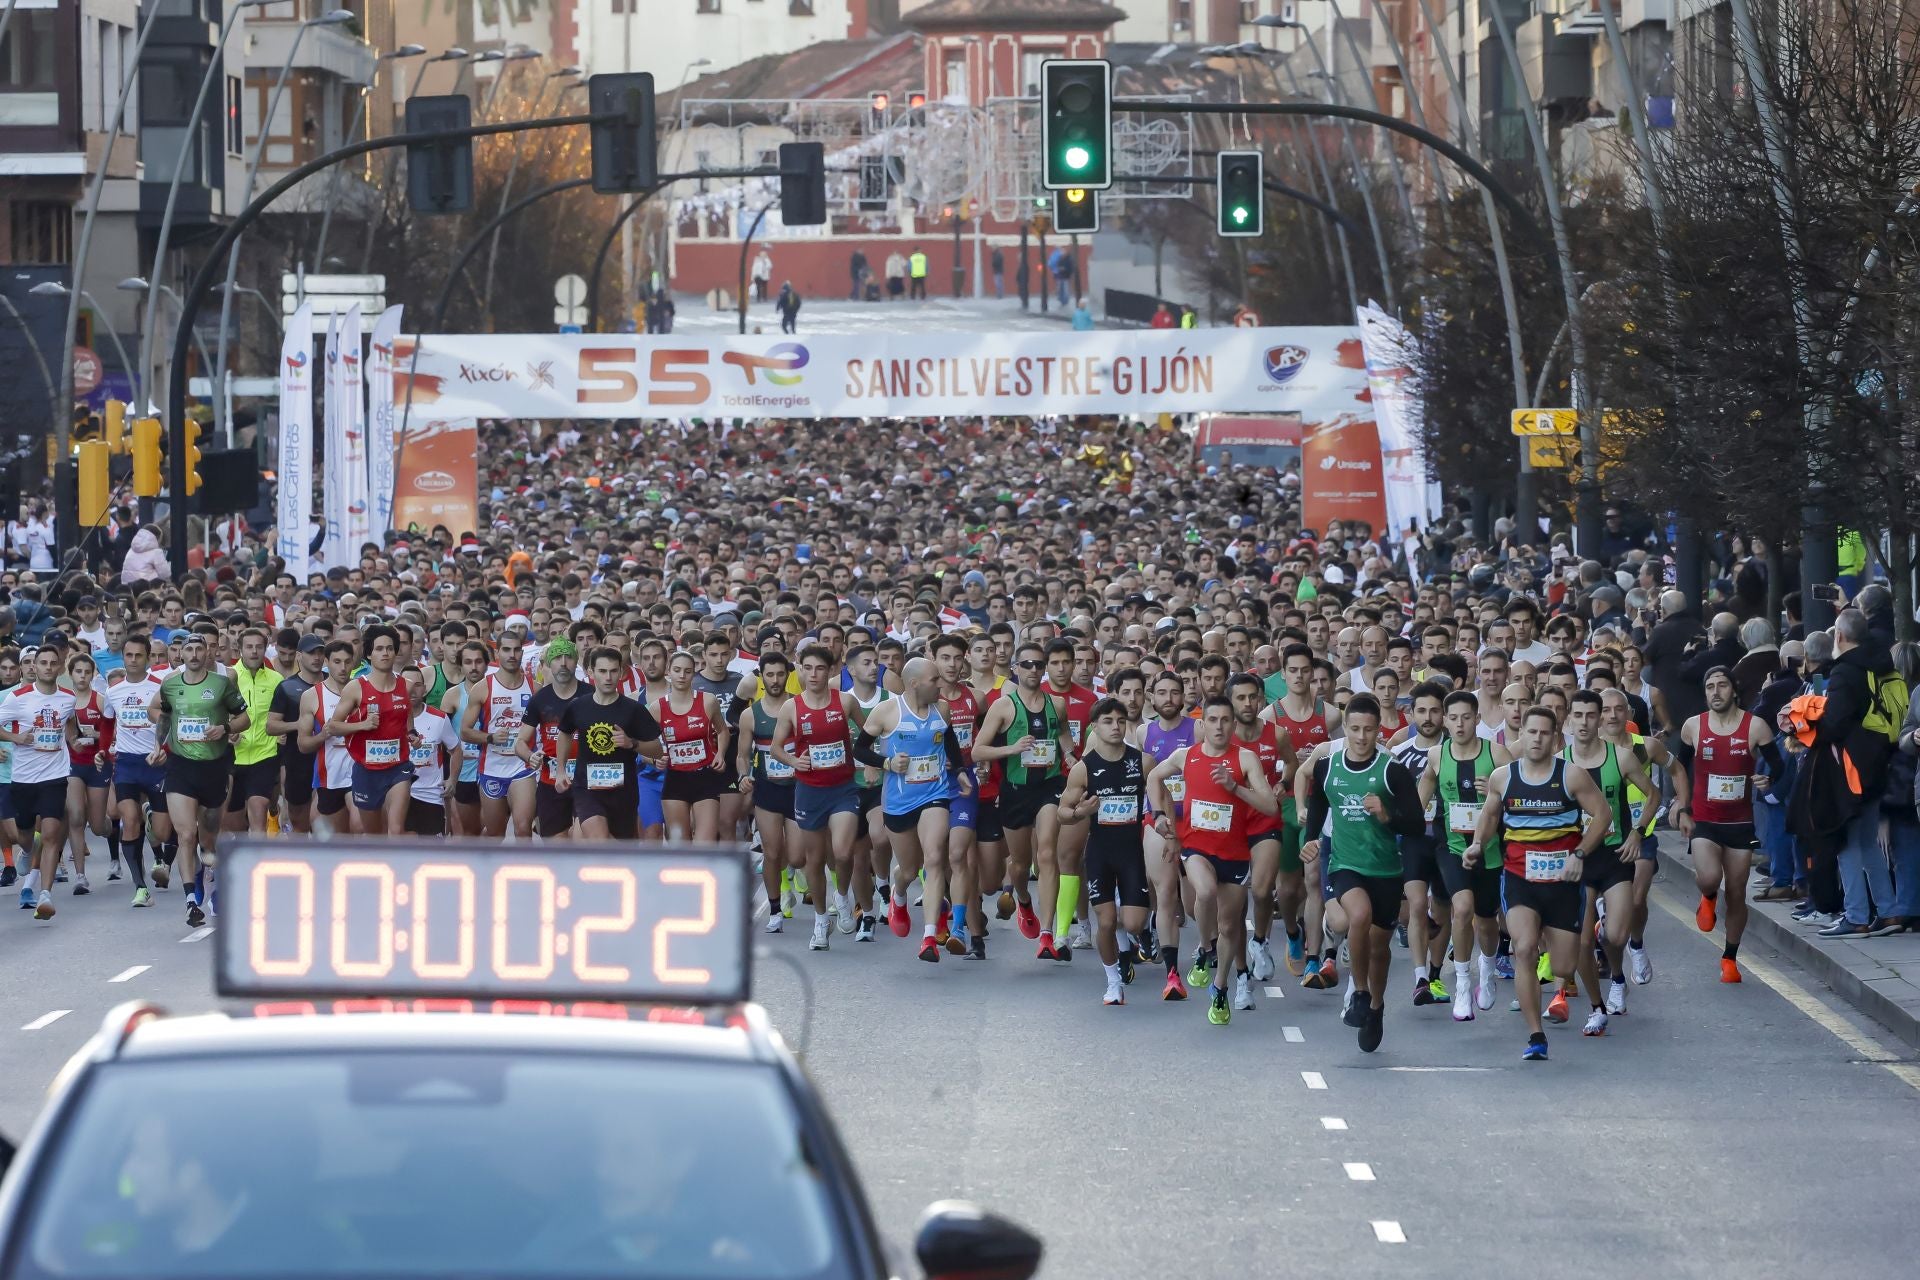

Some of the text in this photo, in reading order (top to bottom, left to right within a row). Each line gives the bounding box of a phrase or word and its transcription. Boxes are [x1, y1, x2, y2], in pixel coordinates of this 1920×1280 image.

[577, 348, 712, 405] 55
[846, 347, 1213, 398] SANSILVESTRE GIJÓN
[723, 395, 811, 409] TotalEnergies
[122, 711, 148, 720] 5220
[369, 746, 397, 756] 4960
[674, 746, 701, 758] 1656
[813, 749, 843, 760] 3220
[1033, 747, 1047, 757] 32
[917, 763, 930, 773] 41
[590, 770, 620, 780] 4236
[1121, 784, 1138, 793] VES
[1720, 783, 1734, 793] 21
[1103, 803, 1132, 814] 4767
[1201, 809, 1219, 822] 40
[1466, 811, 1473, 821] 1
[1530, 859, 1564, 871] 3953
[249, 860, 717, 984] 00:00:22
